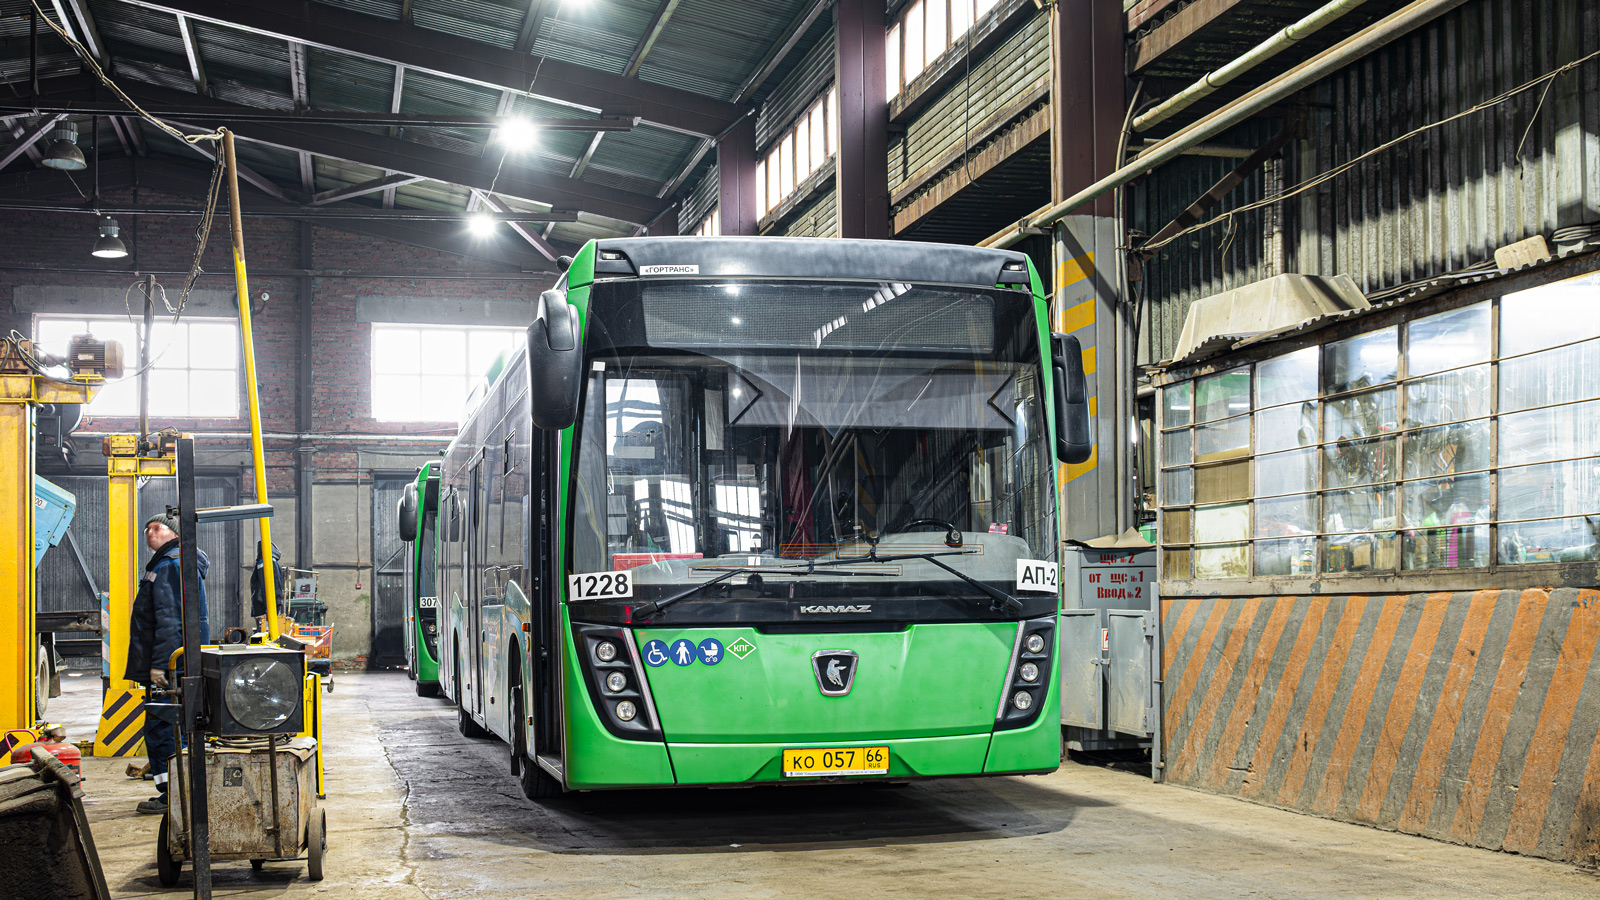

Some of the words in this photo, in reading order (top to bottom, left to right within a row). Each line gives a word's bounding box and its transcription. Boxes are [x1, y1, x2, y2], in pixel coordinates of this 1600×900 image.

[1021, 565, 1056, 587] АП-2
[573, 573, 629, 598] 1228
[800, 605, 872, 613] KAMAZ
[733, 644, 749, 652] КПГ
[823, 751, 855, 768] 057
[866, 749, 883, 762] 66
